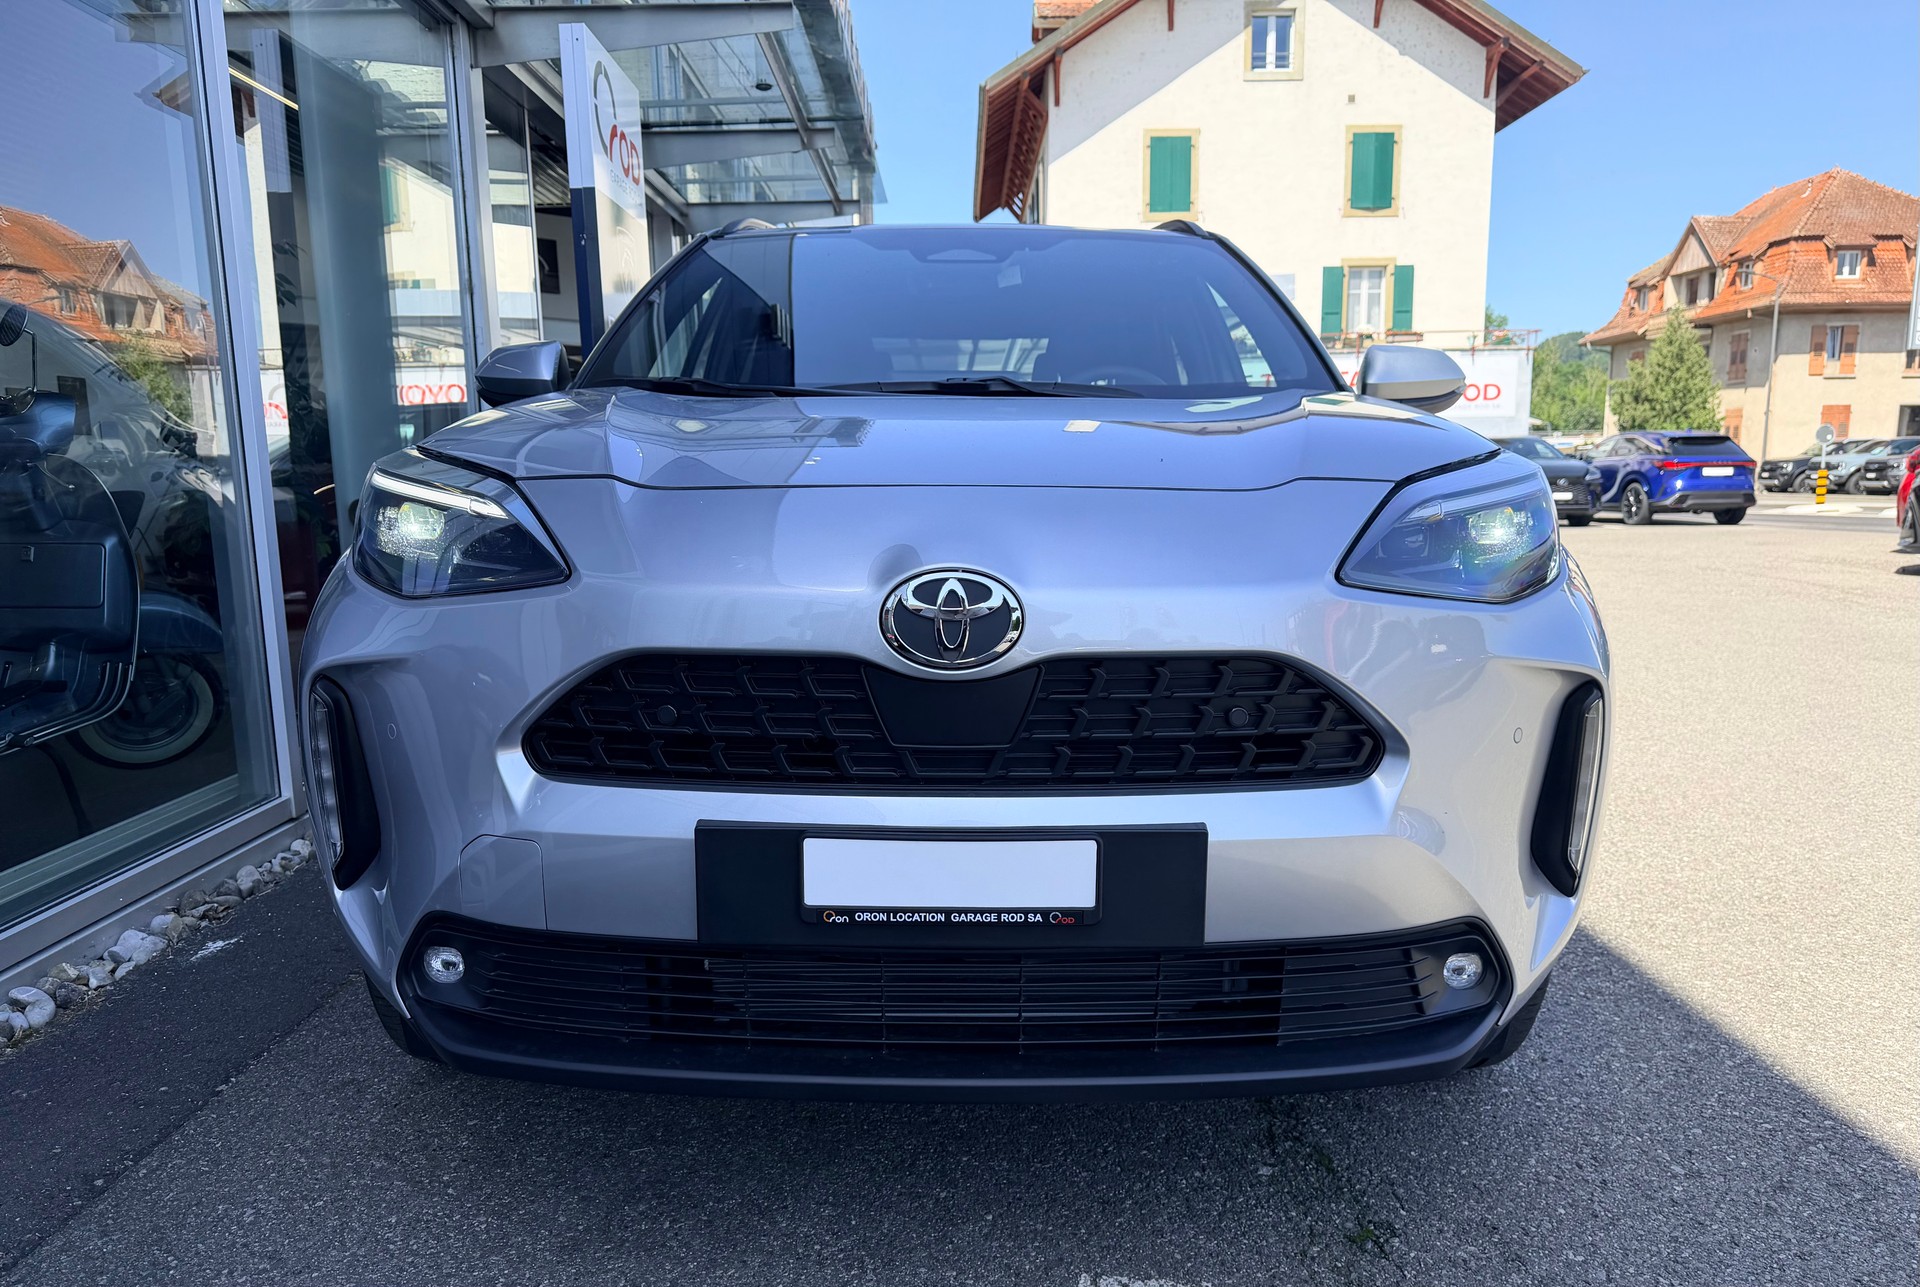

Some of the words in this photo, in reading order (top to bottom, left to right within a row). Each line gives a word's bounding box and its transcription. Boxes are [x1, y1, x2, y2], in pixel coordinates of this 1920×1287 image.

[1463, 383, 1501, 402] OD
[855, 912, 887, 922] ORON
[890, 912, 945, 922] LOCATION
[951, 913, 998, 923] GARAGE
[1001, 913, 1025, 923] ROD
[1027, 913, 1043, 923] SA
